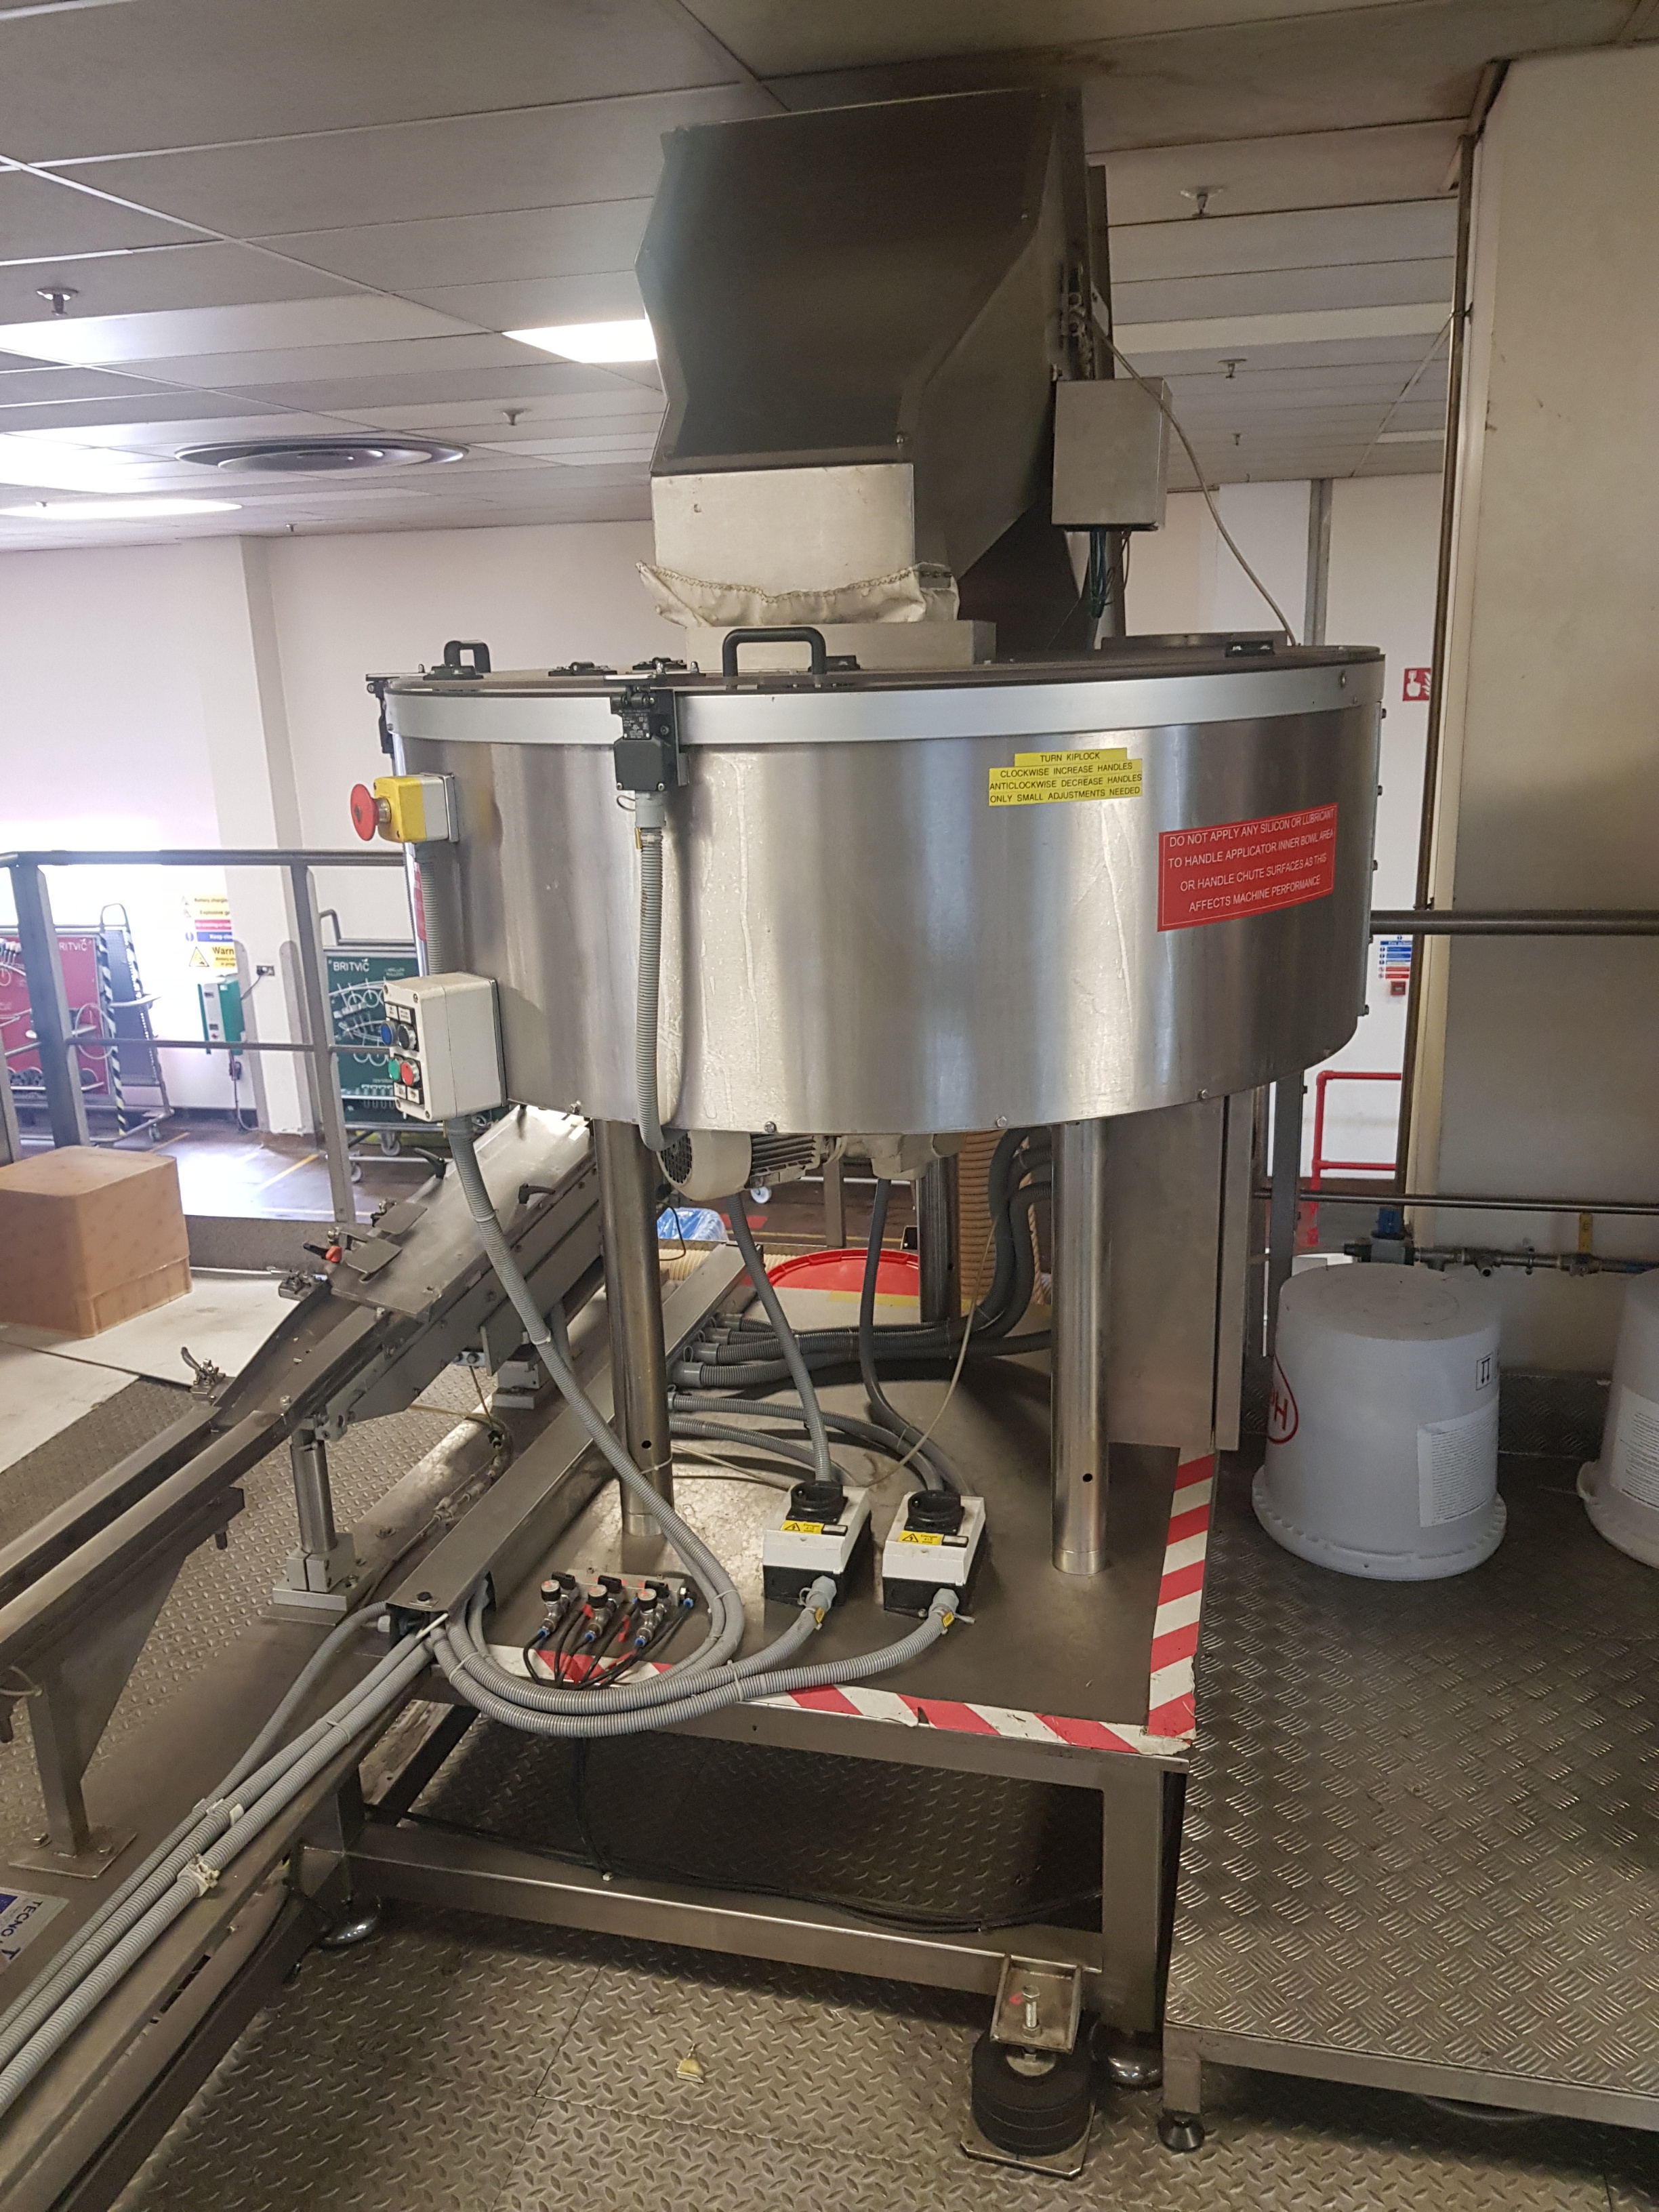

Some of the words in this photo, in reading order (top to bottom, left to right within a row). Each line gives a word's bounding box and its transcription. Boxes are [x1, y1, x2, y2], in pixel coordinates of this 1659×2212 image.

[1040, 754, 1062, 762] TURN
[1067, 752, 1101, 760] KIPLOCK
[1000, 768, 1049, 778] CLOCKWISE
[1053, 765, 1093, 775] INCREASE
[1097, 762, 1132, 772] HANDLES
[989, 780, 1057, 790] ANTICLOCKWISE
[1061, 777, 1103, 787] DECREASE
[1107, 774, 1142, 784] HANDLES
[990, 794, 1012, 803] ONLY
[1017, 793, 1043, 802] SMALL
[1048, 790, 1105, 800] ADJUSTMENTS
[1109, 786, 1140, 796] NEEDED
[1170, 836, 1185, 847] DO
[1187, 832, 1208, 845] NOT
[1210, 828, 1239, 842] APPLY
[1241, 825, 1258, 837] ANY
[1260, 820, 1290, 834] SILICON
[1291, 817, 1302, 828] OR
[1303, 808, 1334, 825] LUBRICANT
[1168, 857, 1183, 868] TO
[1185, 851, 1223, 866] HANDLE
[1225, 842, 1277, 861] APPLICATOR
[1278, 838, 1299, 850] INNER
[1300, 834, 1317, 846] BOWL
[1318, 829, 1333, 840] AREA
[1180, 880, 1195, 892] OR
[1197, 874, 1234, 889] HANDLE
[1236, 868, 1265, 883] CHUTE
[1266, 859, 1304, 877] SURFACES
[1305, 857, 1314, 867] AS
[1314, 853, 1327, 865] THIS
[1189, 896, 1230, 912] AFFECTS
[1233, 888, 1270, 905] MACHINE
[1271, 875, 1321, 897] PERFORMANCE
[58, 940, 88, 951] RITVIC
[212, 947, 234, 955] Warn
[333, 960, 369, 972] BRITVIC
